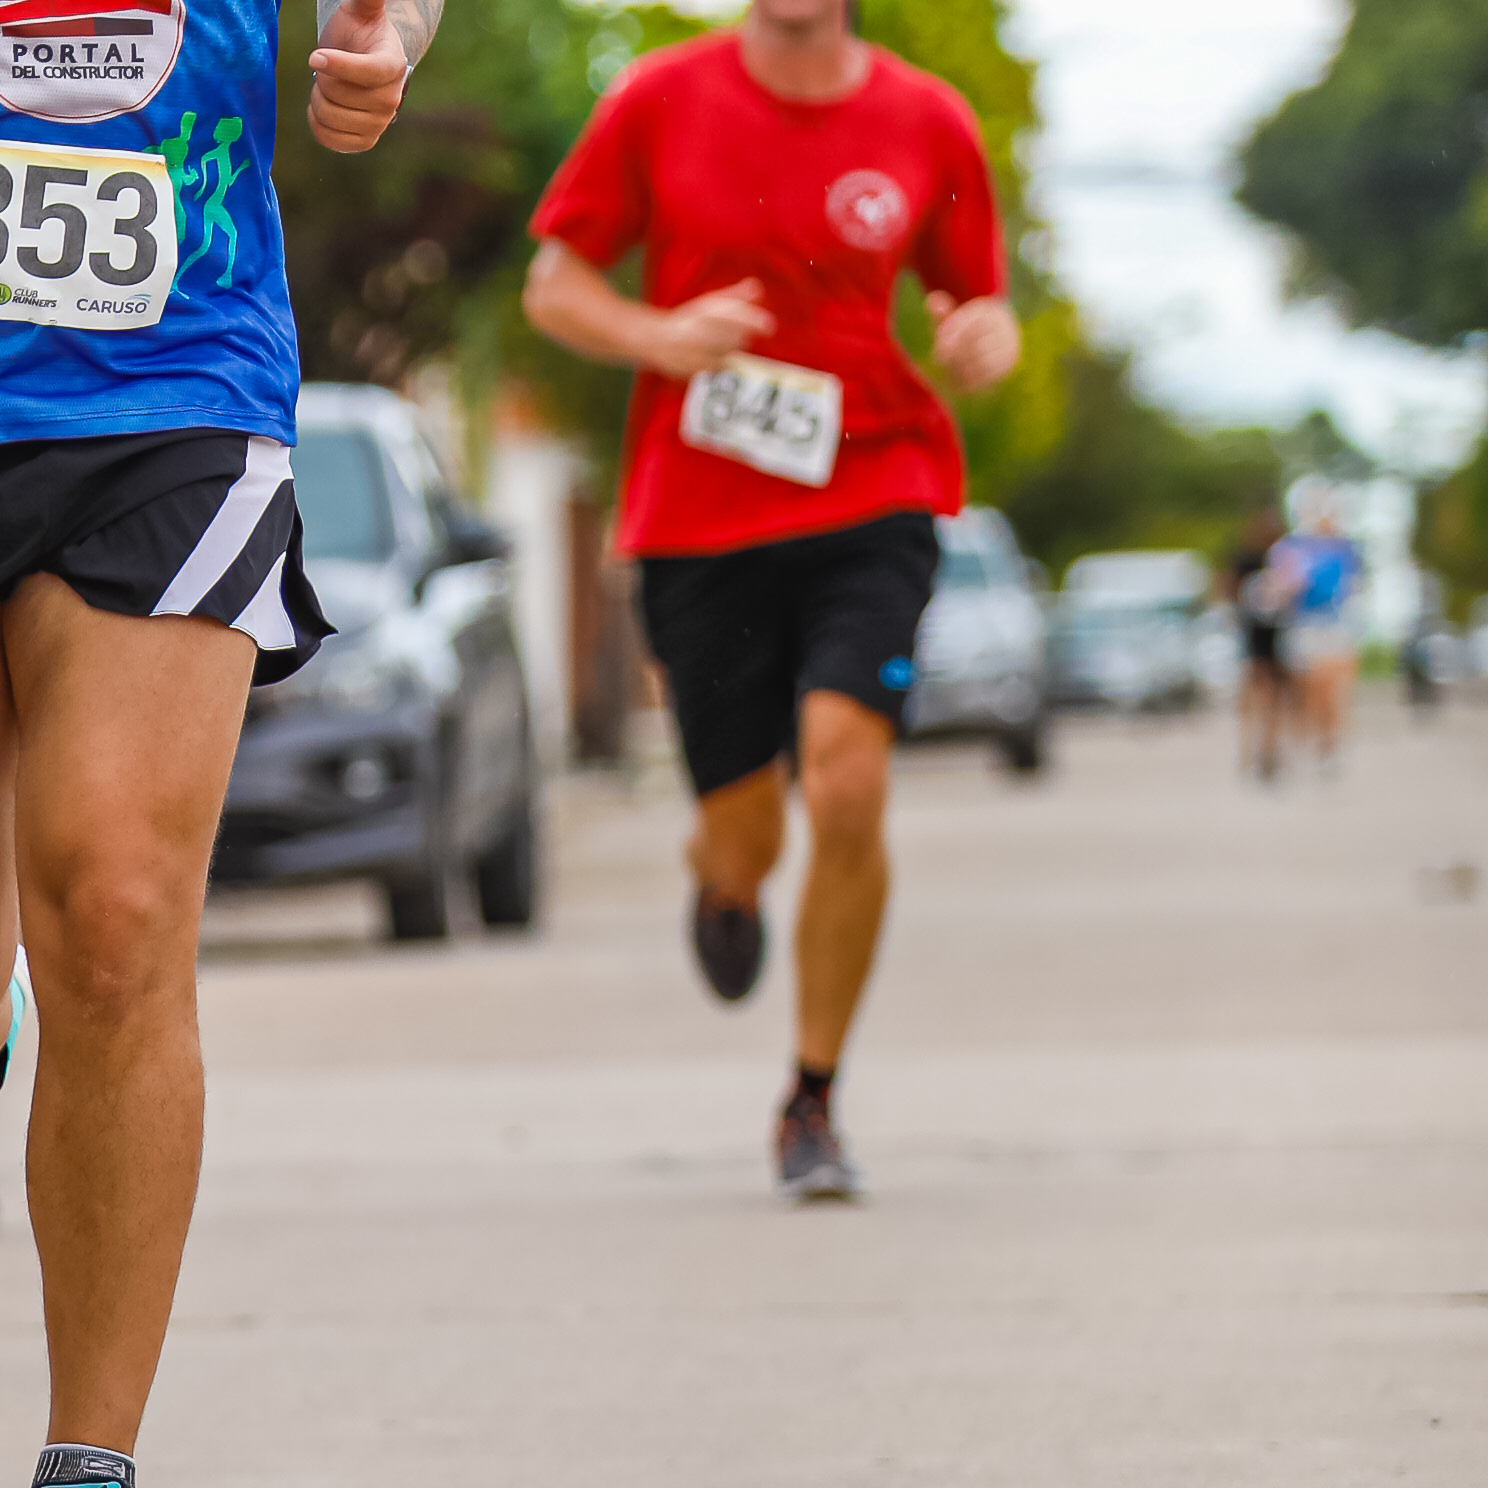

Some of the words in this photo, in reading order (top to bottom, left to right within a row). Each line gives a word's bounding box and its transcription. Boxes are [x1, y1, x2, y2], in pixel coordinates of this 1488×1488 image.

[12, 43, 144, 63] PORTAL
[12, 66, 40, 79] DEL
[43, 65, 144, 79] CONSTRUCTOR
[14, 288, 38, 299] CLUB
[76, 298, 148, 314] CARUSO
